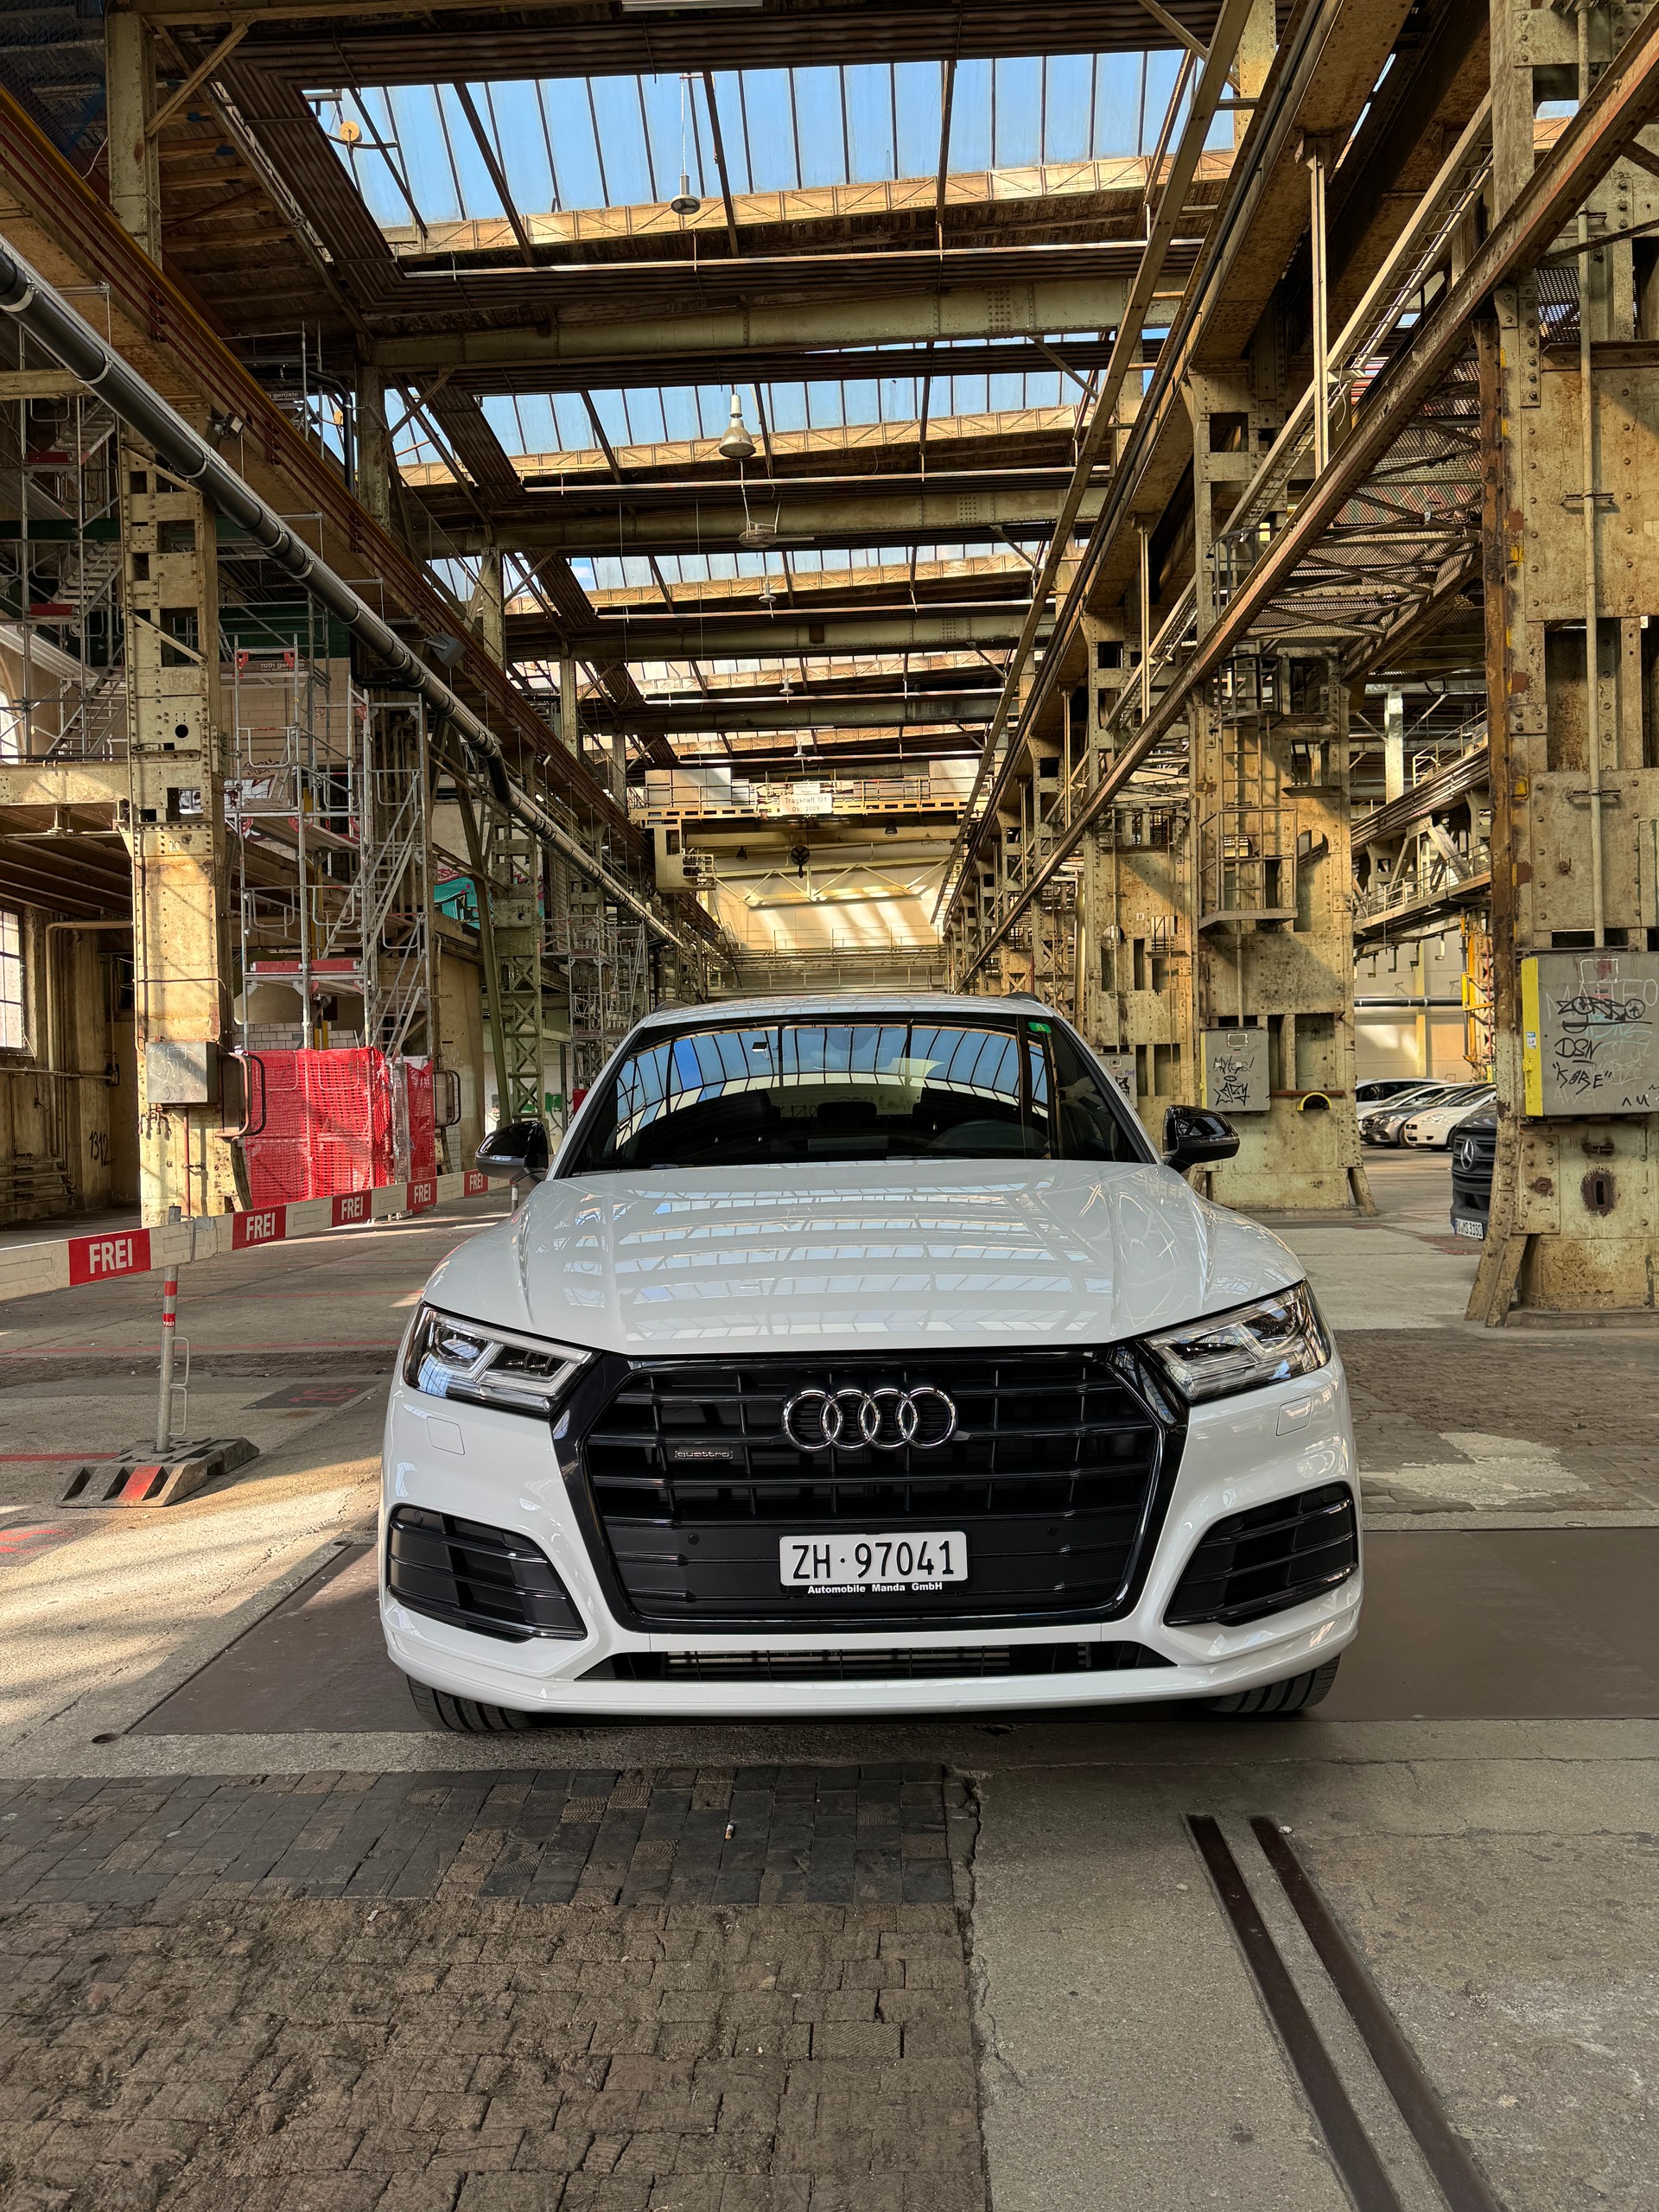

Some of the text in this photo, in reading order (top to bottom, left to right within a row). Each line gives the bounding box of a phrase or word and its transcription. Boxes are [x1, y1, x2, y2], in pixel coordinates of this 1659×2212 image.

[413, 1183, 431, 1205] FREI
[469, 1173, 483, 1192] FREI
[340, 1196, 364, 1220] FREI
[245, 1212, 276, 1242] FREI
[89, 1238, 133, 1274] FREI
[807, 1581, 943, 1594] Automobile Manda GmbH
